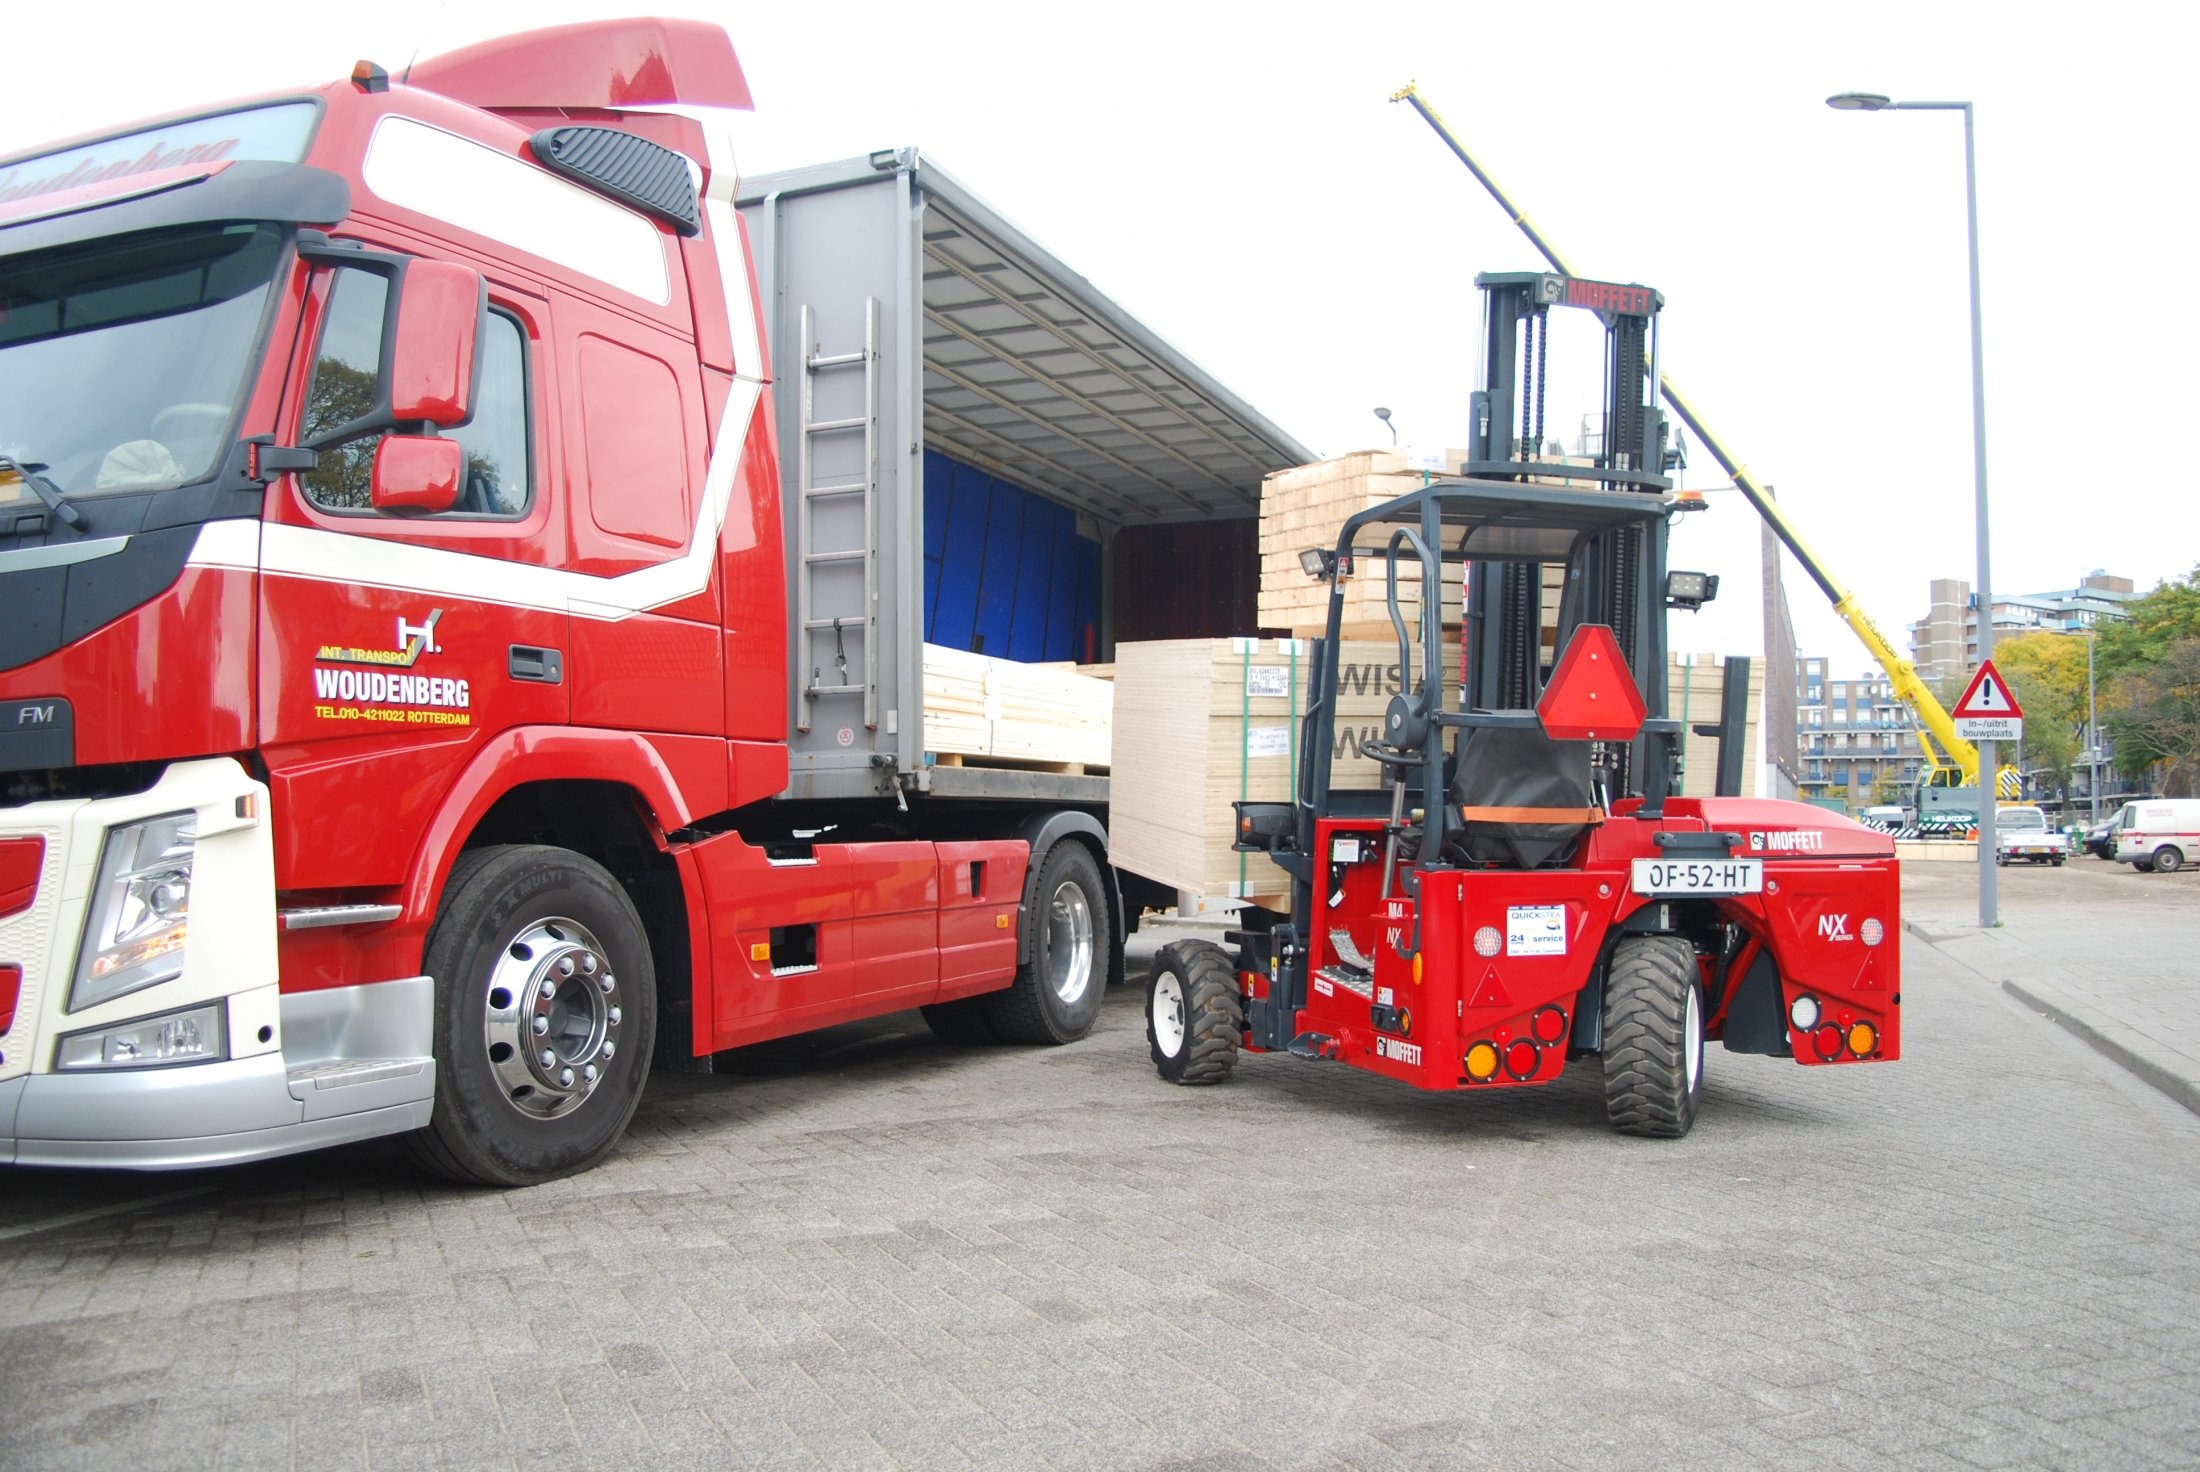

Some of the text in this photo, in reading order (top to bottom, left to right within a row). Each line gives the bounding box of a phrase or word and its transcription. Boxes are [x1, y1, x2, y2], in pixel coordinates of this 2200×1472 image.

[1568, 279, 1649, 314] MOFFETT
[321, 646, 344, 659] INT.
[315, 668, 469, 707] WOUDENBERG
[19, 706, 54, 724] FM
[408, 711, 470, 725] ROTTERDAM
[1962, 730, 2013, 739] bouwplaats
[1767, 831, 1823, 850] MOFFETT
[1649, 864, 1751, 888] OF-52-HT
[1388, 901, 1404, 919] M4
[1817, 913, 1848, 942] NX
[1386, 926, 1402, 950] NX
[1510, 934, 1564, 943] 24 service
[1386, 1037, 1422, 1067] MOFFETT
